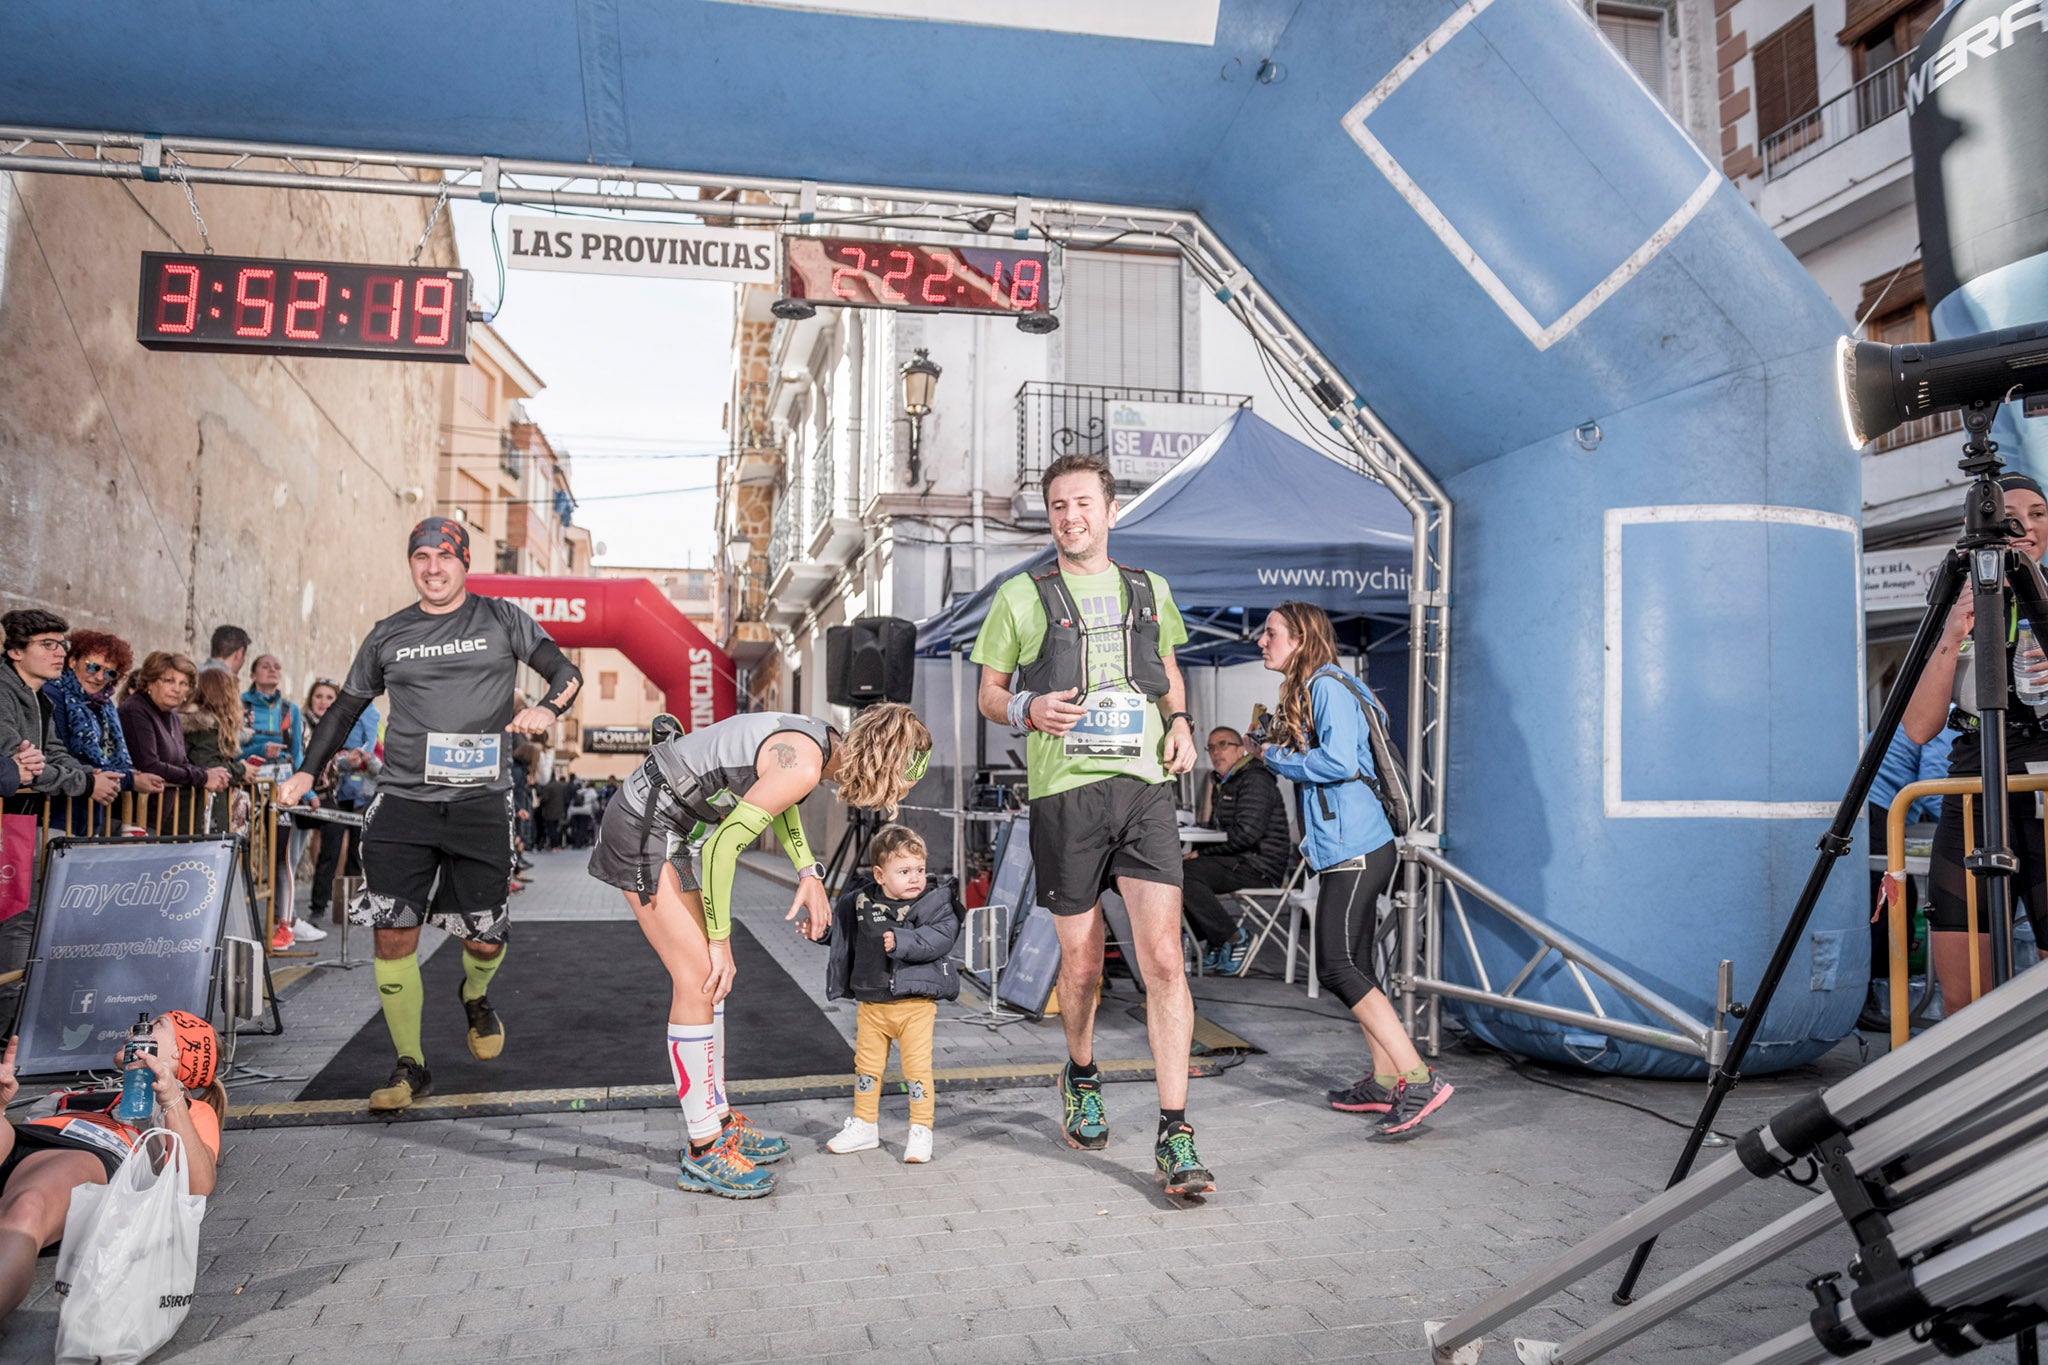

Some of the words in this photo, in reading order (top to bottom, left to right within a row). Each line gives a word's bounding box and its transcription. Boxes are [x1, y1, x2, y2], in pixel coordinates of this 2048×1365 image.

[512, 228, 573, 260] LAS
[581, 233, 772, 272] PROVINCIAS
[832, 246, 1042, 309] 2:22:18
[158, 263, 454, 346] 3:52:19
[1115, 431, 1141, 456] SE
[1864, 562, 1913, 576] ICERÍA
[499, 596, 586, 623] NCIAS
[395, 638, 488, 661] Primelec
[1083, 711, 1131, 728] 1089
[443, 749, 485, 763] 1073
[60, 873, 190, 916] mychip
[50, 937, 204, 960] www.mychip.es
